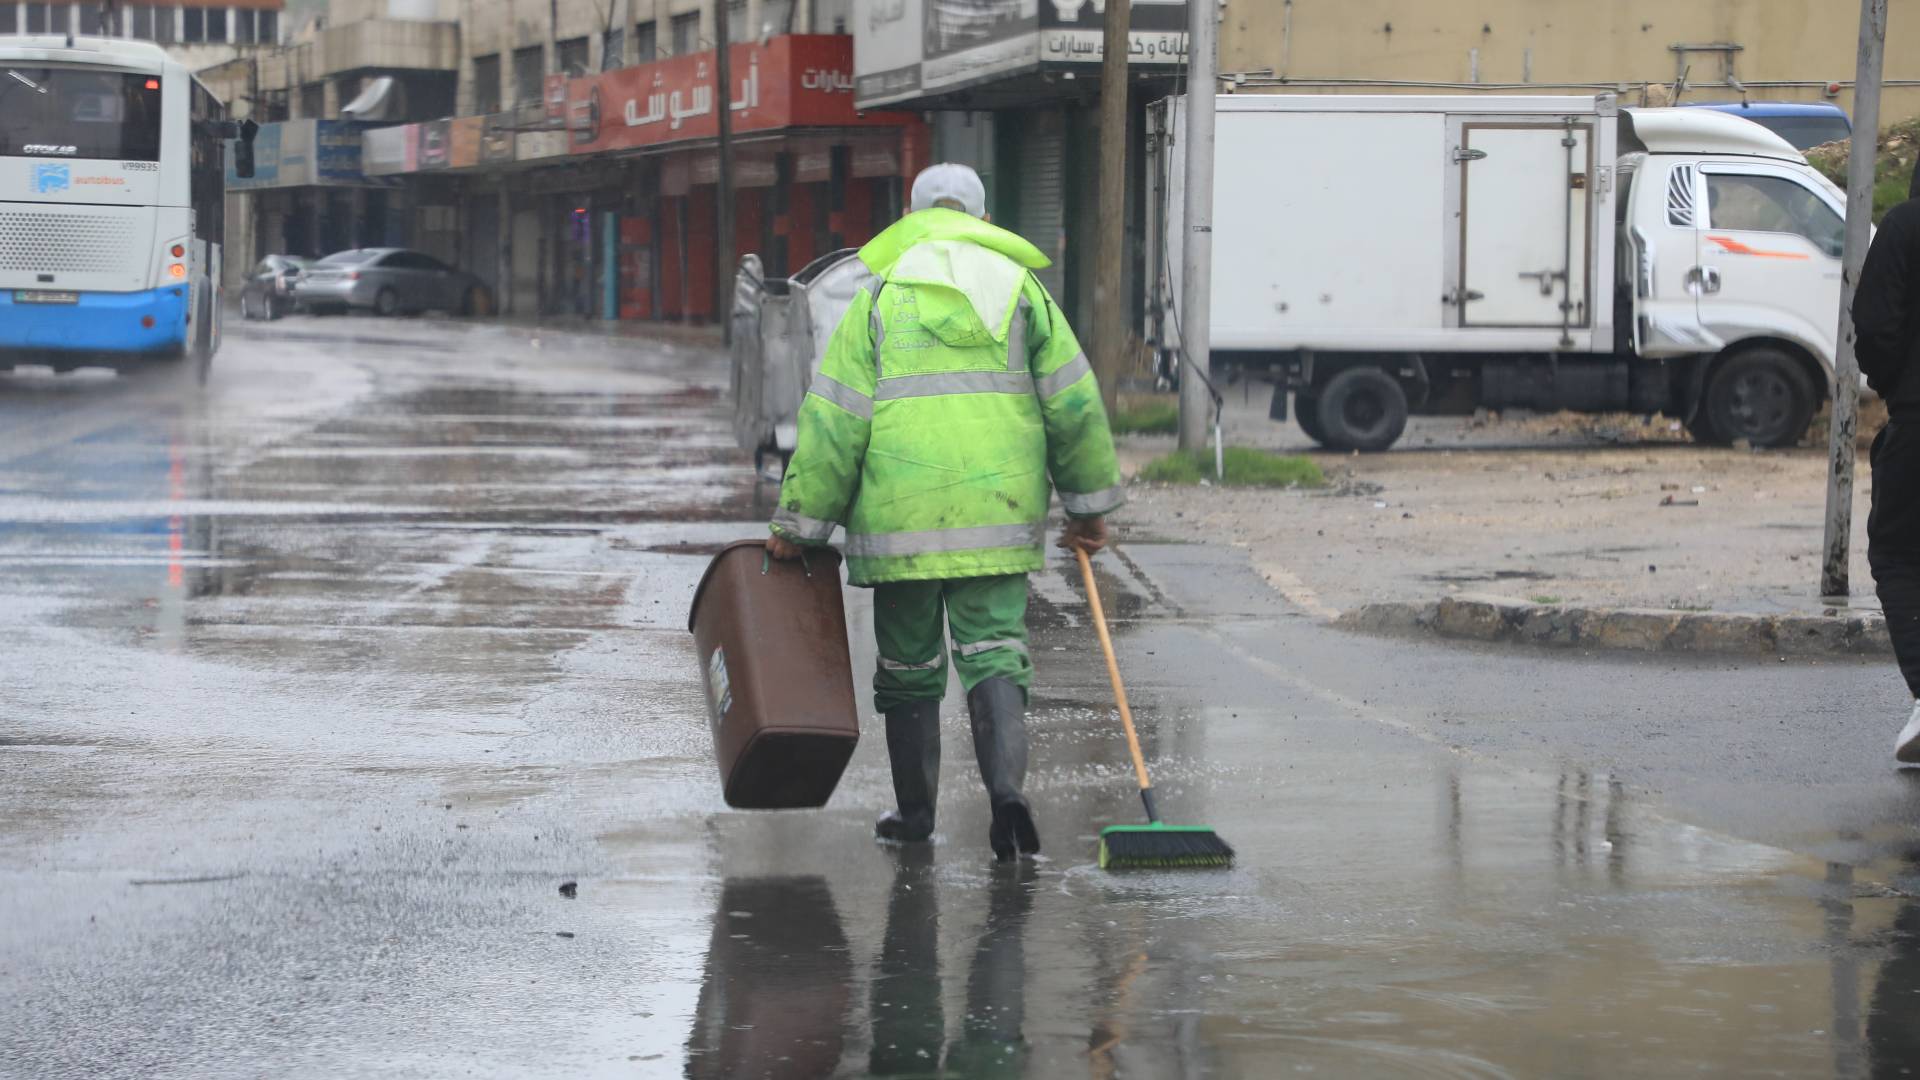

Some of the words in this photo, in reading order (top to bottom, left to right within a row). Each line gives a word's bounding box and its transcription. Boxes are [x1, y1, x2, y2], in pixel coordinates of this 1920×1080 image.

[1050, 35, 1094, 58] سيارات
[802, 67, 854, 93] يارات
[23, 144, 78, 155] OTOKAR
[122, 161, 158, 172] V99935
